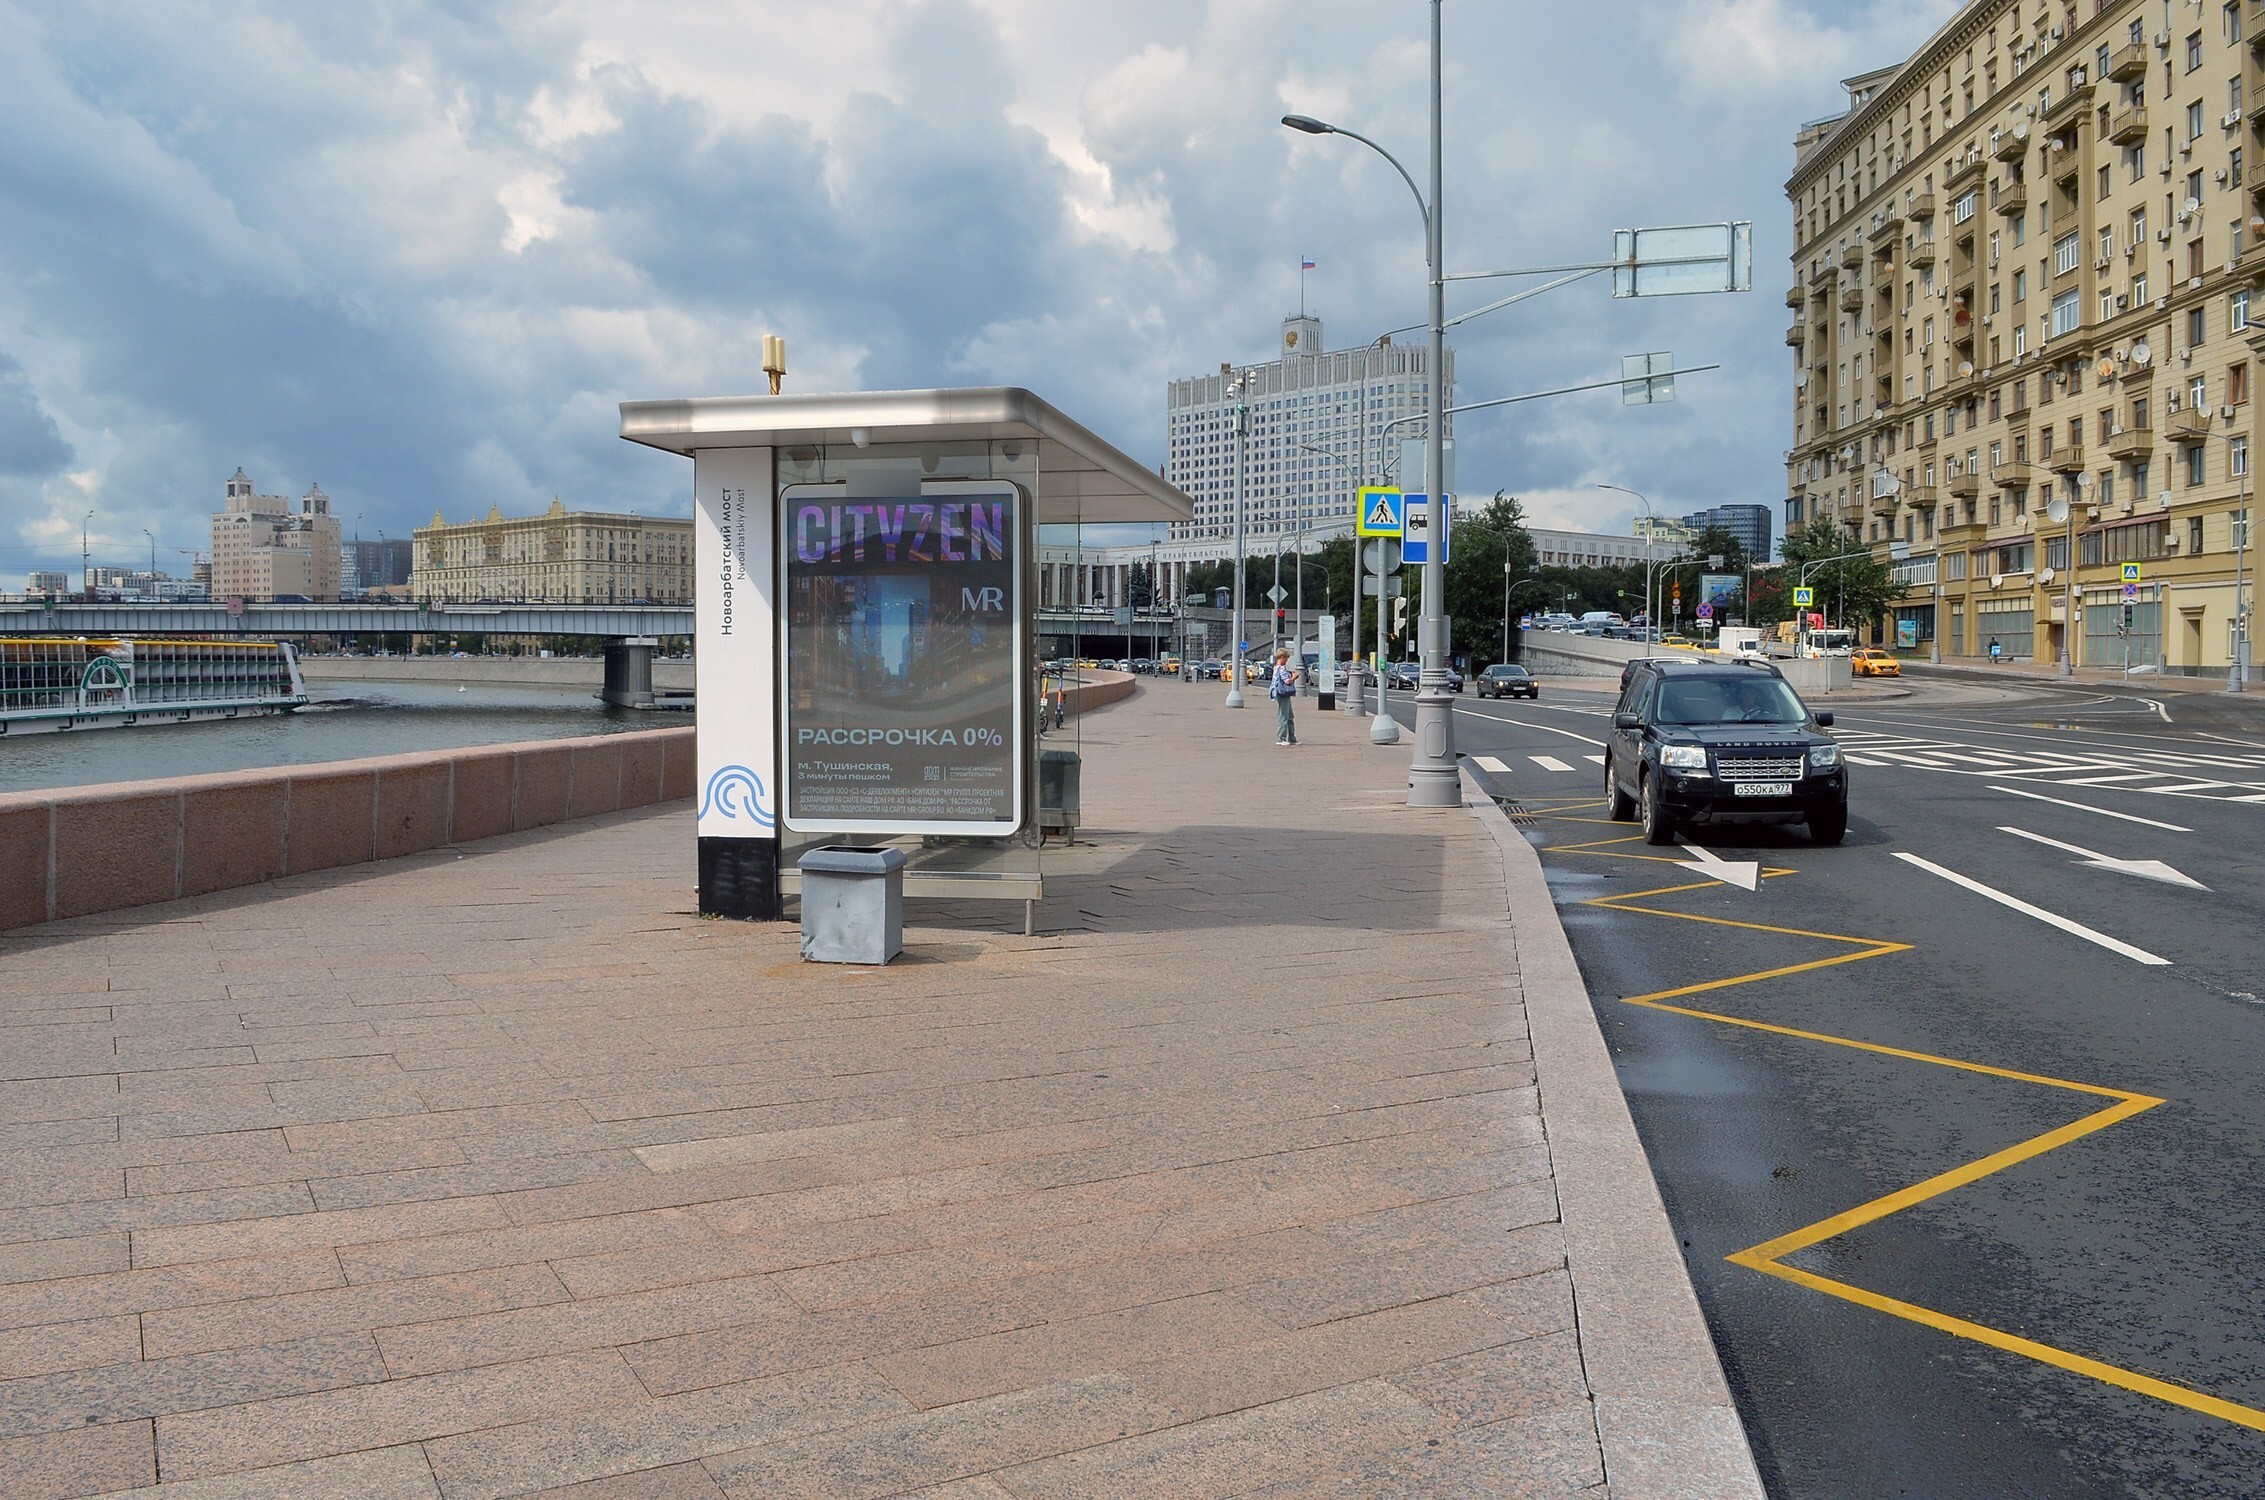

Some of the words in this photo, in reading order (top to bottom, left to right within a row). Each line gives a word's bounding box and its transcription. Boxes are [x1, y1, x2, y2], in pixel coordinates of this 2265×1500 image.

[722, 487, 731, 521] мост
[736, 489, 745, 512] Most
[796, 503, 1003, 564] CITYZEN
[736, 514, 746, 580] Novoarbatskiy
[1162, 549, 1229, 559] ПРАВИТЕЛЬСТВА
[720, 527, 734, 635] Новоарбатский
[961, 586, 1004, 612] MR
[798, 728, 958, 746] РАССРОЧКА
[963, 727, 1003, 746] 0%
[798, 762, 811, 771] м.
[807, 773, 848, 781] минуты
[849, 773, 890, 781] пешком
